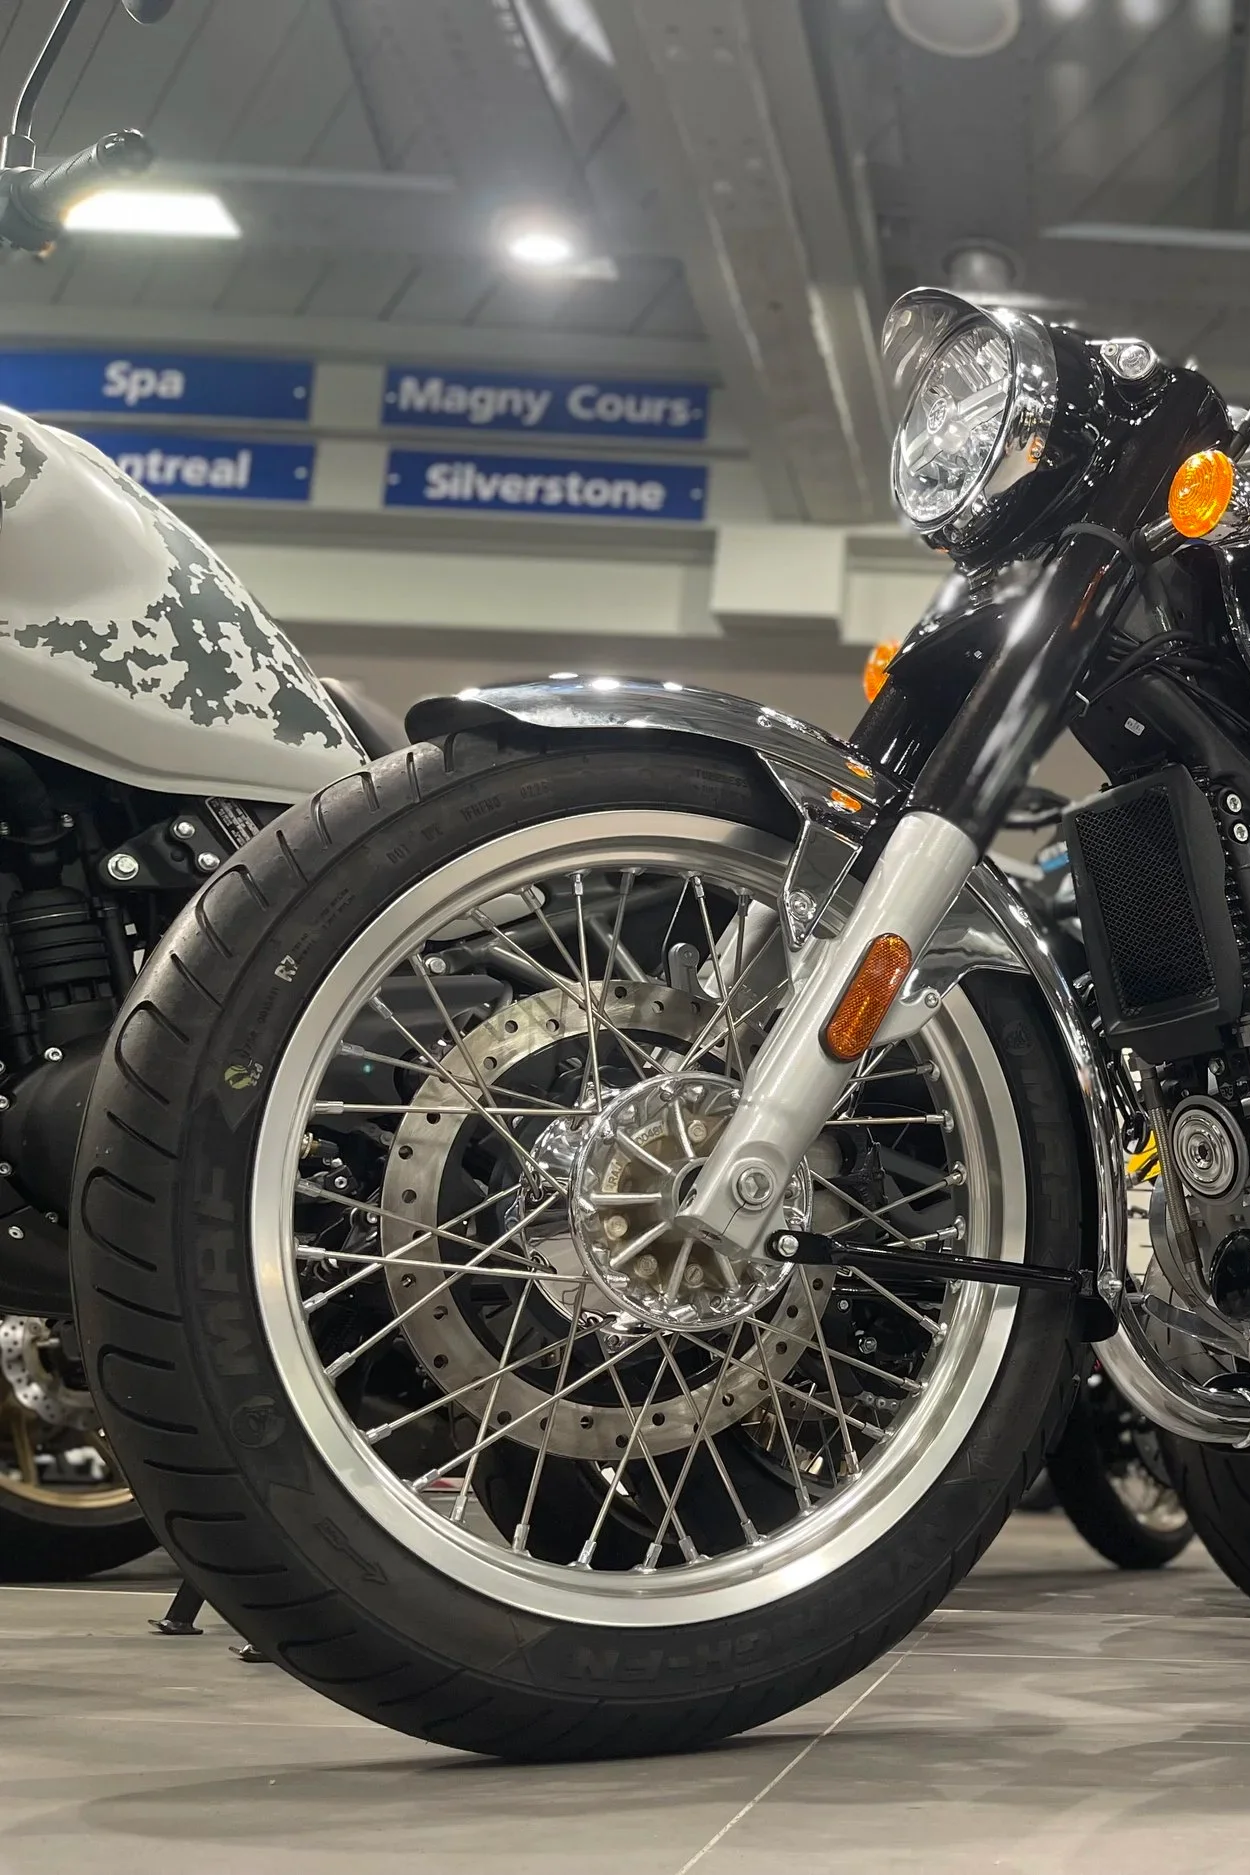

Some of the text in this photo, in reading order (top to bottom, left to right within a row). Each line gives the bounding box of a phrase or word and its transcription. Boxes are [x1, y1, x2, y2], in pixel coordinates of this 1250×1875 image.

[104, 361, 185, 402] Spa
[400, 377, 689, 426] Magny Cours
[117, 448, 252, 490] ntreal
[424, 463, 665, 510] Silverstone
